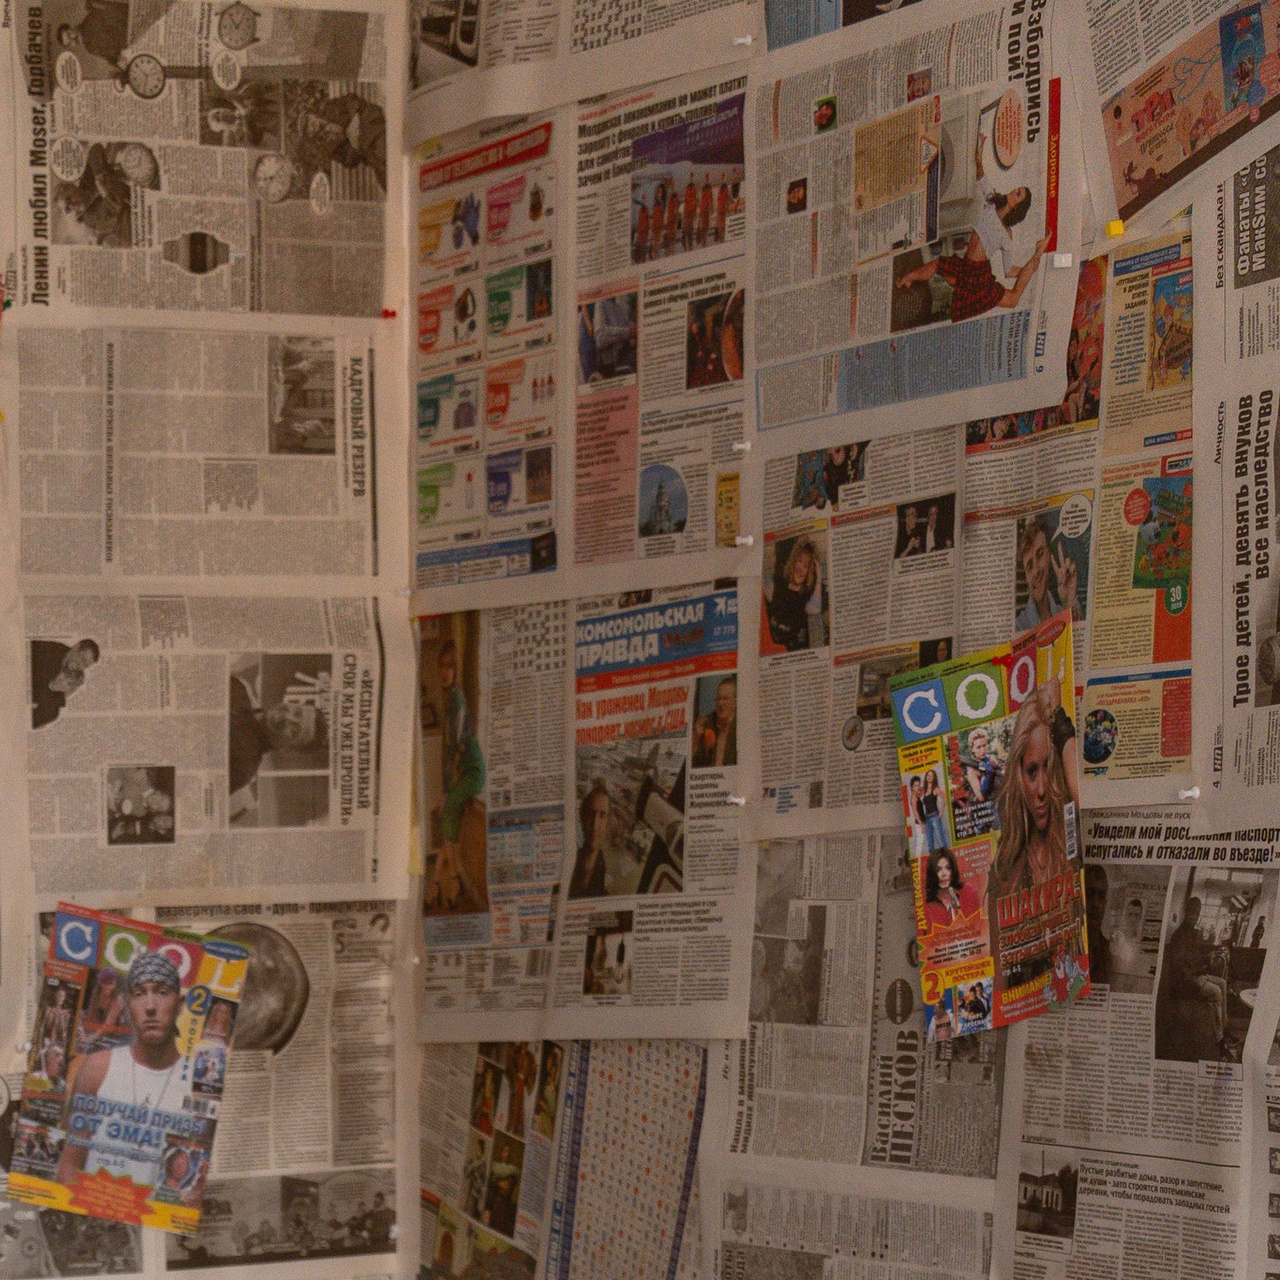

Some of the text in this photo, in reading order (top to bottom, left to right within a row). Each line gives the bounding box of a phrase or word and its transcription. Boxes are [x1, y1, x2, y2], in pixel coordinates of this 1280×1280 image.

[30, 101, 47, 168] Moser,
[1048, 132, 1058, 198] Здоровье
[30, 172, 49, 239] любил
[1237, 191, 1250, 276] Фанаты
[1216, 196, 1225, 289] Без скандала
[31, 247, 50, 306] Ленин
[350, 356, 367, 498] КАДРОВЫЙ РЕЗЕРВ
[1214, 401, 1225, 466] Личность
[1255, 389, 1274, 580] все наследство
[1233, 394, 1253, 708] Трое детей, девять внуков
[575, 602, 705, 644] КОМСОМОЛЬСКАЯ
[1170, 585, 1182, 602] 30
[575, 632, 660, 670] ПРАВДА
[340, 653, 357, 826] СРОК МЫ УЖЕ ПРОШЛИ»
[1084, 844, 1143, 860] испугались
[1146, 846, 1152, 859] и
[1156, 846, 1211, 861] отказали
[1212, 847, 1226, 861] во
[1087, 822, 1161, 841] «Увидели мой
[60, 921, 242, 994] COOL
[192, 988, 205, 1013] 2
[924, 972, 940, 1003] 2
[72, 1114, 103, 1135] ОТ
[73, 1094, 148, 1123] ПОЛУЧАЙ
[870, 1055, 894, 1163] Василий
[1078, 1185, 1230, 1215] деревни, чтобы порадовать западных гостей
[1079, 1164, 1225, 1194] Пустые разбитые дома, разор и запустение,
[1079, 1176, 1206, 1201] ни души строятся потемкинские
